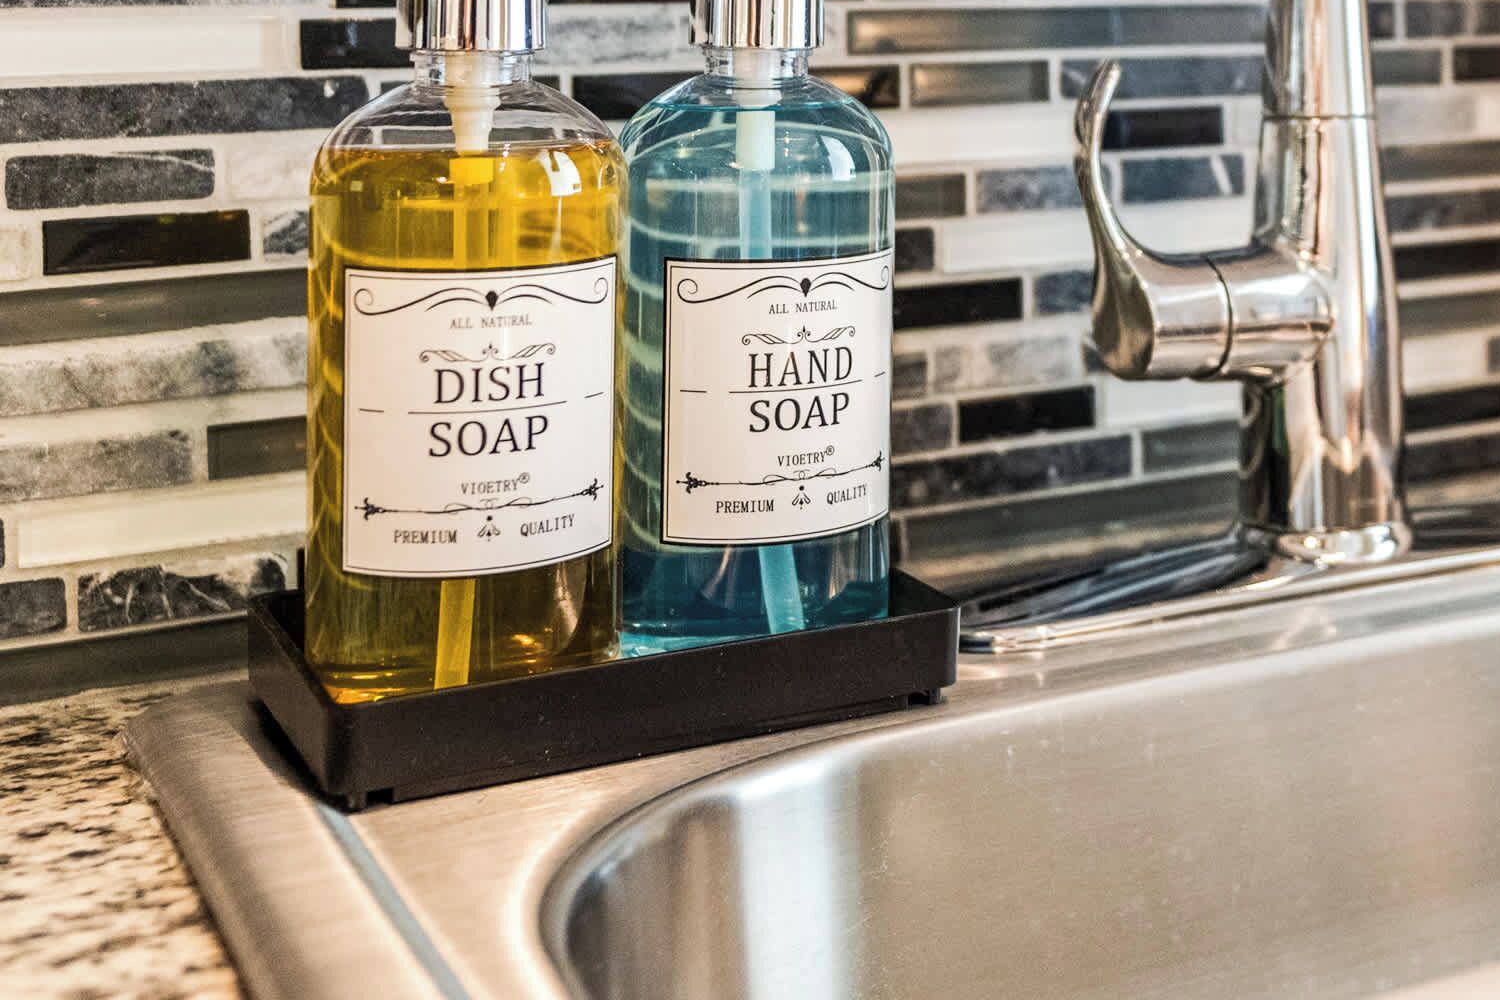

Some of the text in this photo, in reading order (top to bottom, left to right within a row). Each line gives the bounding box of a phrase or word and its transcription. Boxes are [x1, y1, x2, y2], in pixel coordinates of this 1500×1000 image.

[450, 313, 533, 329] ALL NATURAL
[768, 299, 838, 315] ALL NATURAL
[433, 362, 545, 404] DISH
[747, 346, 853, 388] HAND
[748, 392, 850, 433] SOAP
[428, 414, 550, 458] SOAP
[715, 483, 867, 514] PREMIUM QUALITY
[393, 514, 575, 544] PREMIUM QUALITY
